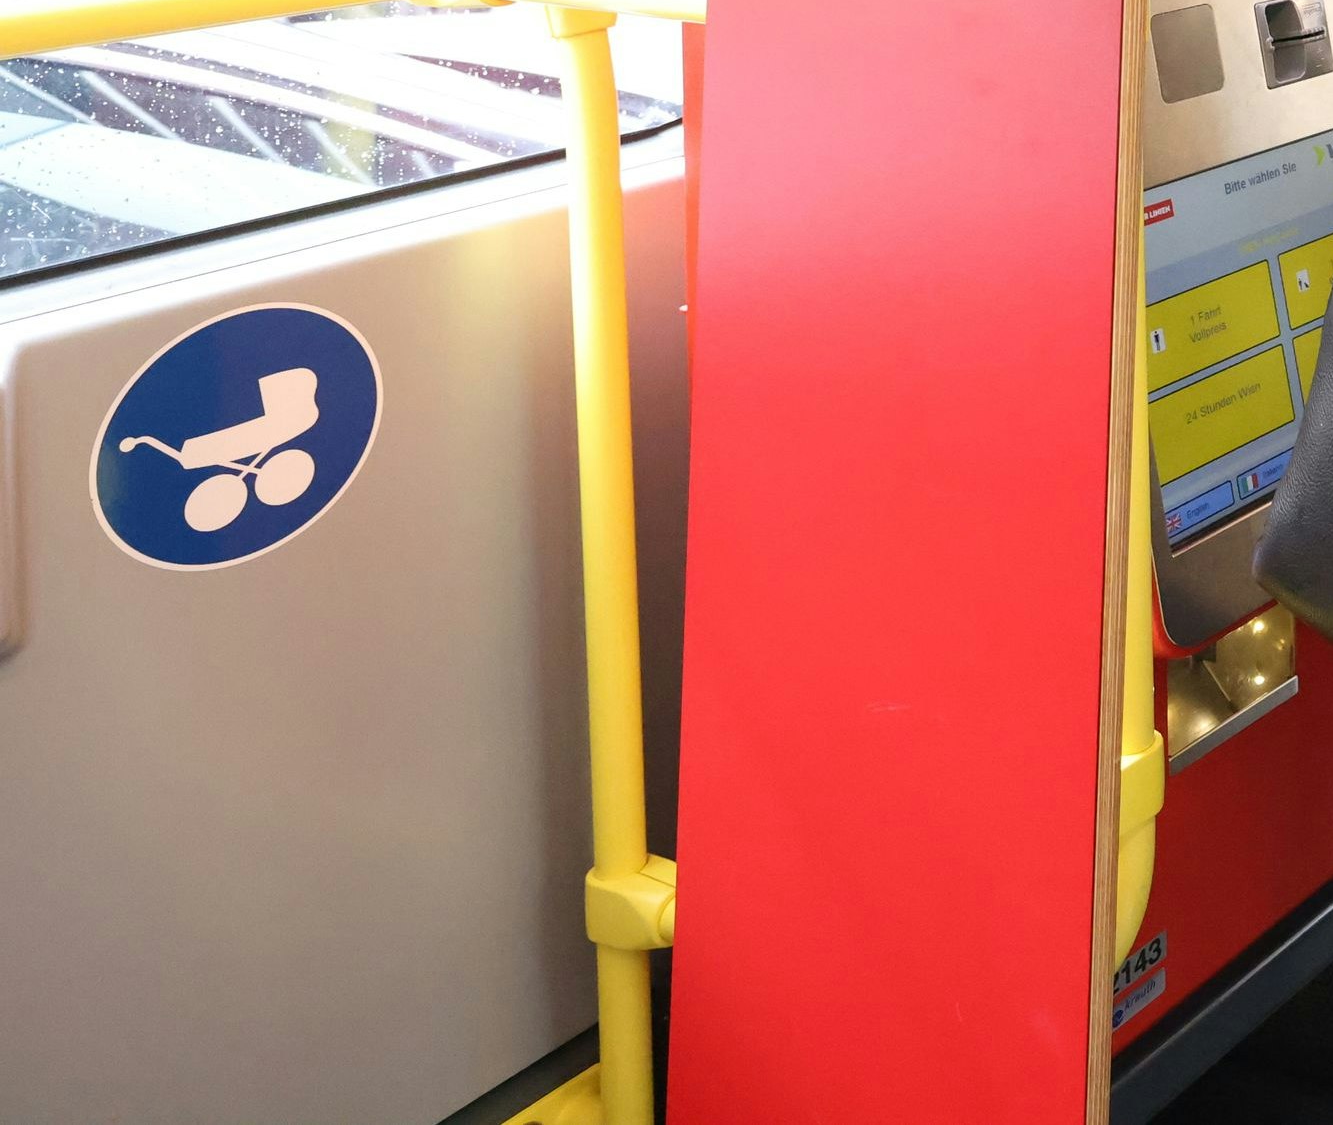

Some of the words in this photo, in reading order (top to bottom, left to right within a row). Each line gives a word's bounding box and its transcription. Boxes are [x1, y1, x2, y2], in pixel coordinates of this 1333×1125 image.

[1224, 180, 1247, 195] Bitte
[1249, 169, 1281, 187] wählen
[1282, 161, 1297, 176] Sie
[1199, 306, 1222, 323] Fahrt
[1189, 322, 1228, 343] Vollpreis
[1186, 411, 1198, 424] 24
[1200, 394, 1237, 418] Stunden
[1238, 382, 1262, 400] Wien
